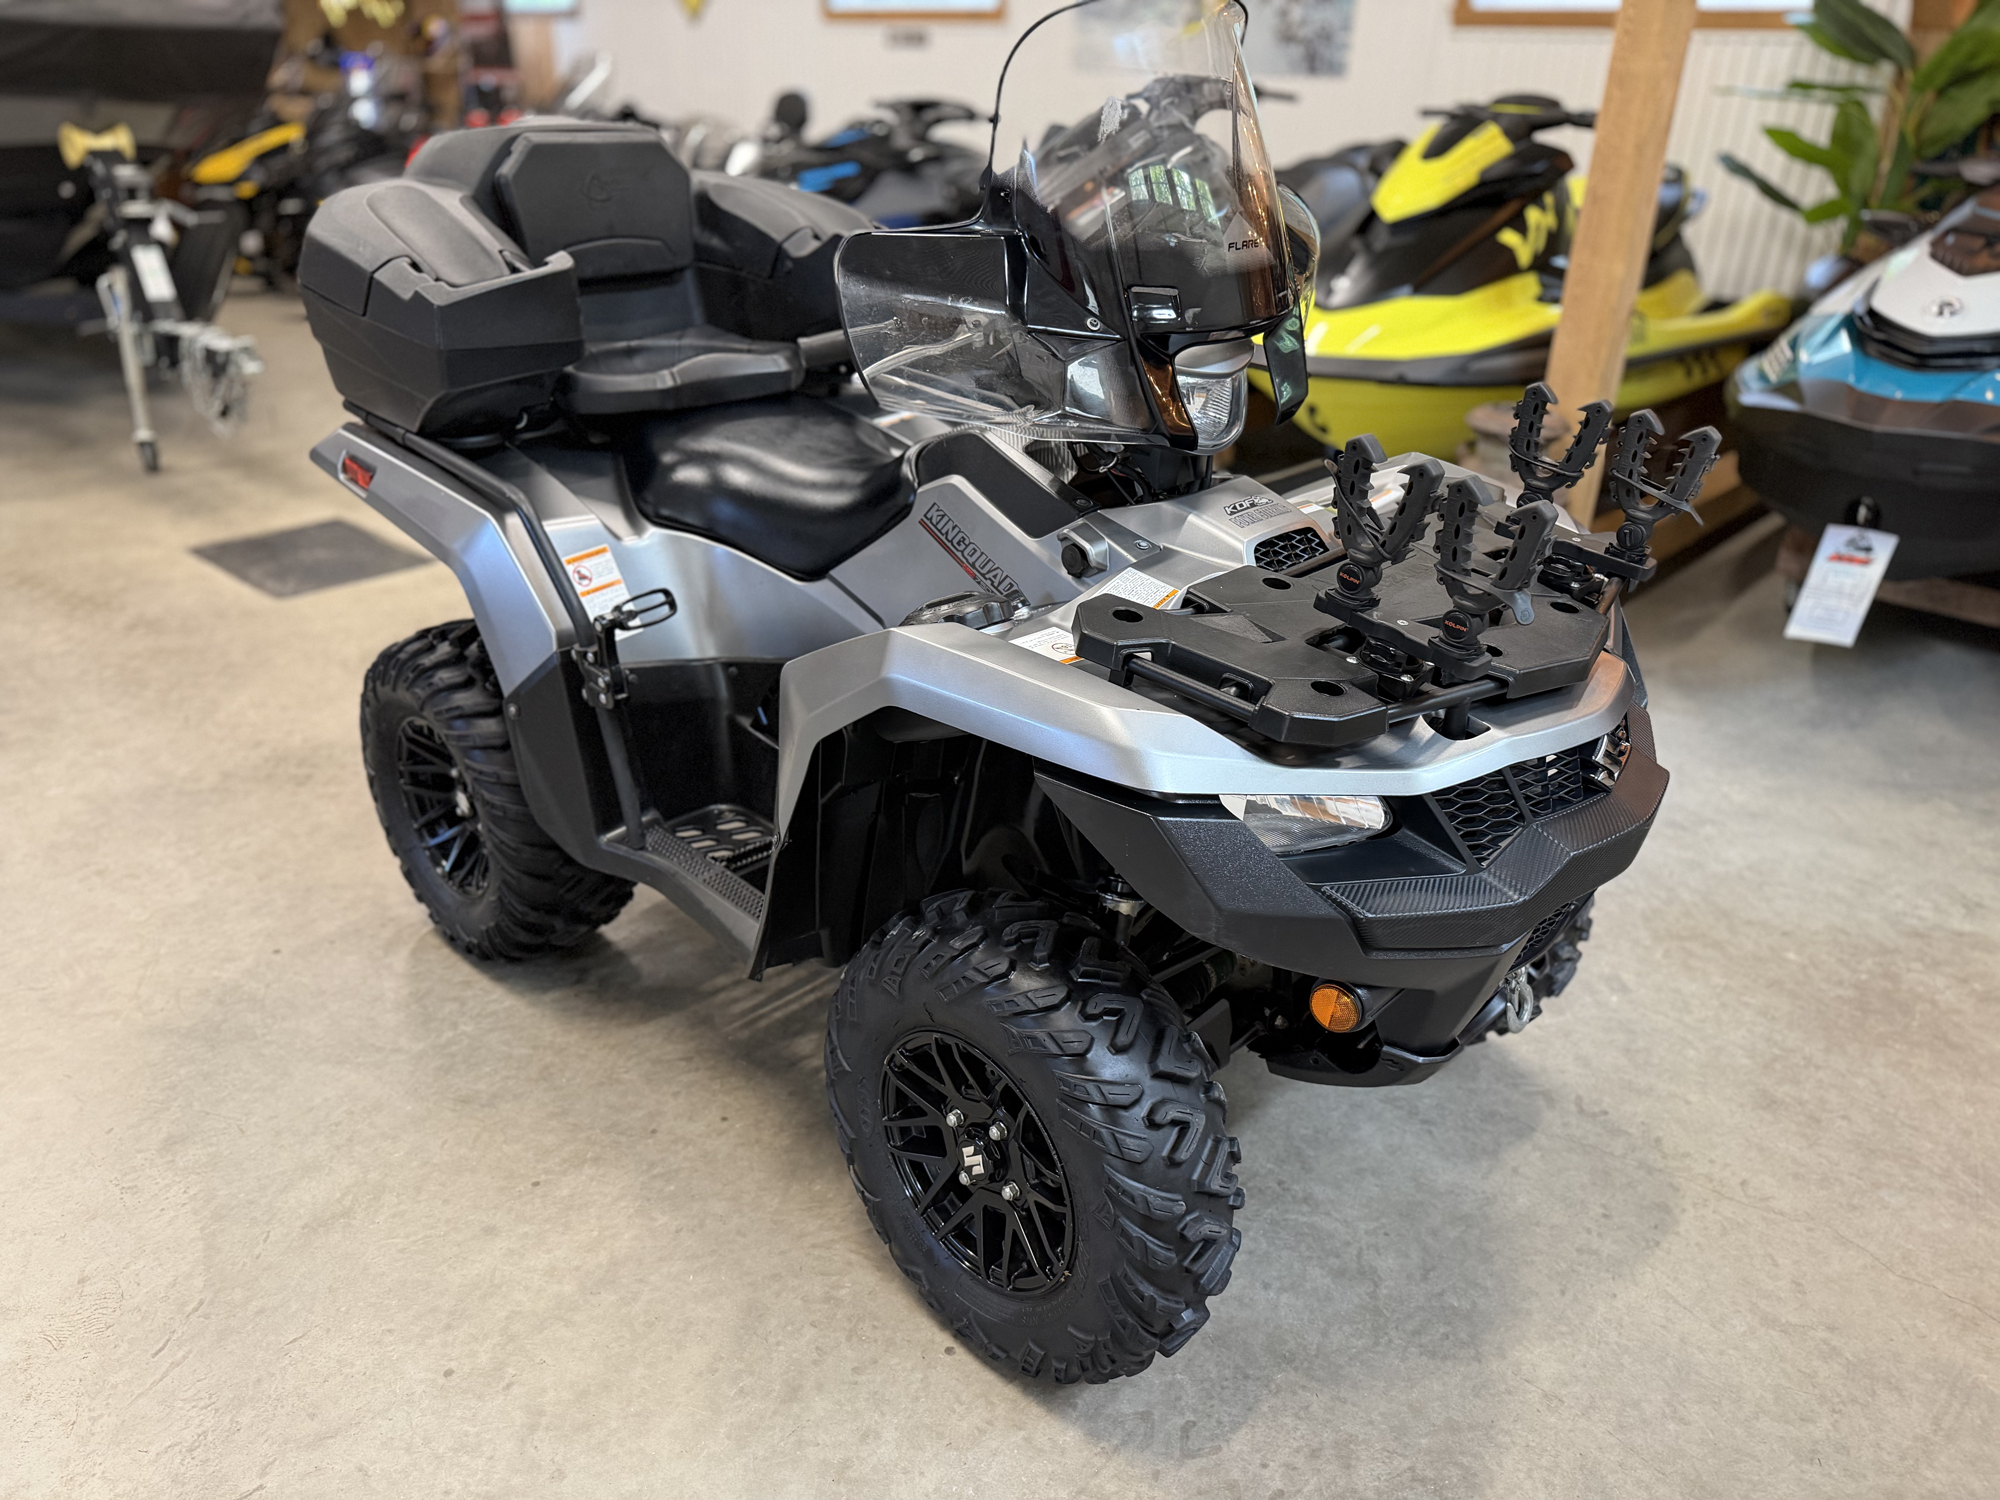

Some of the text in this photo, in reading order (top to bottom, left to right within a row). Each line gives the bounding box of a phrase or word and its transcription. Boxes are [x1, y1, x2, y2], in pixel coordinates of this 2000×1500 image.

[1228, 239, 1260, 252] FLARE
[923, 502, 1020, 597] KINGQUAD
[1444, 619, 1468, 632] KOLPIN
